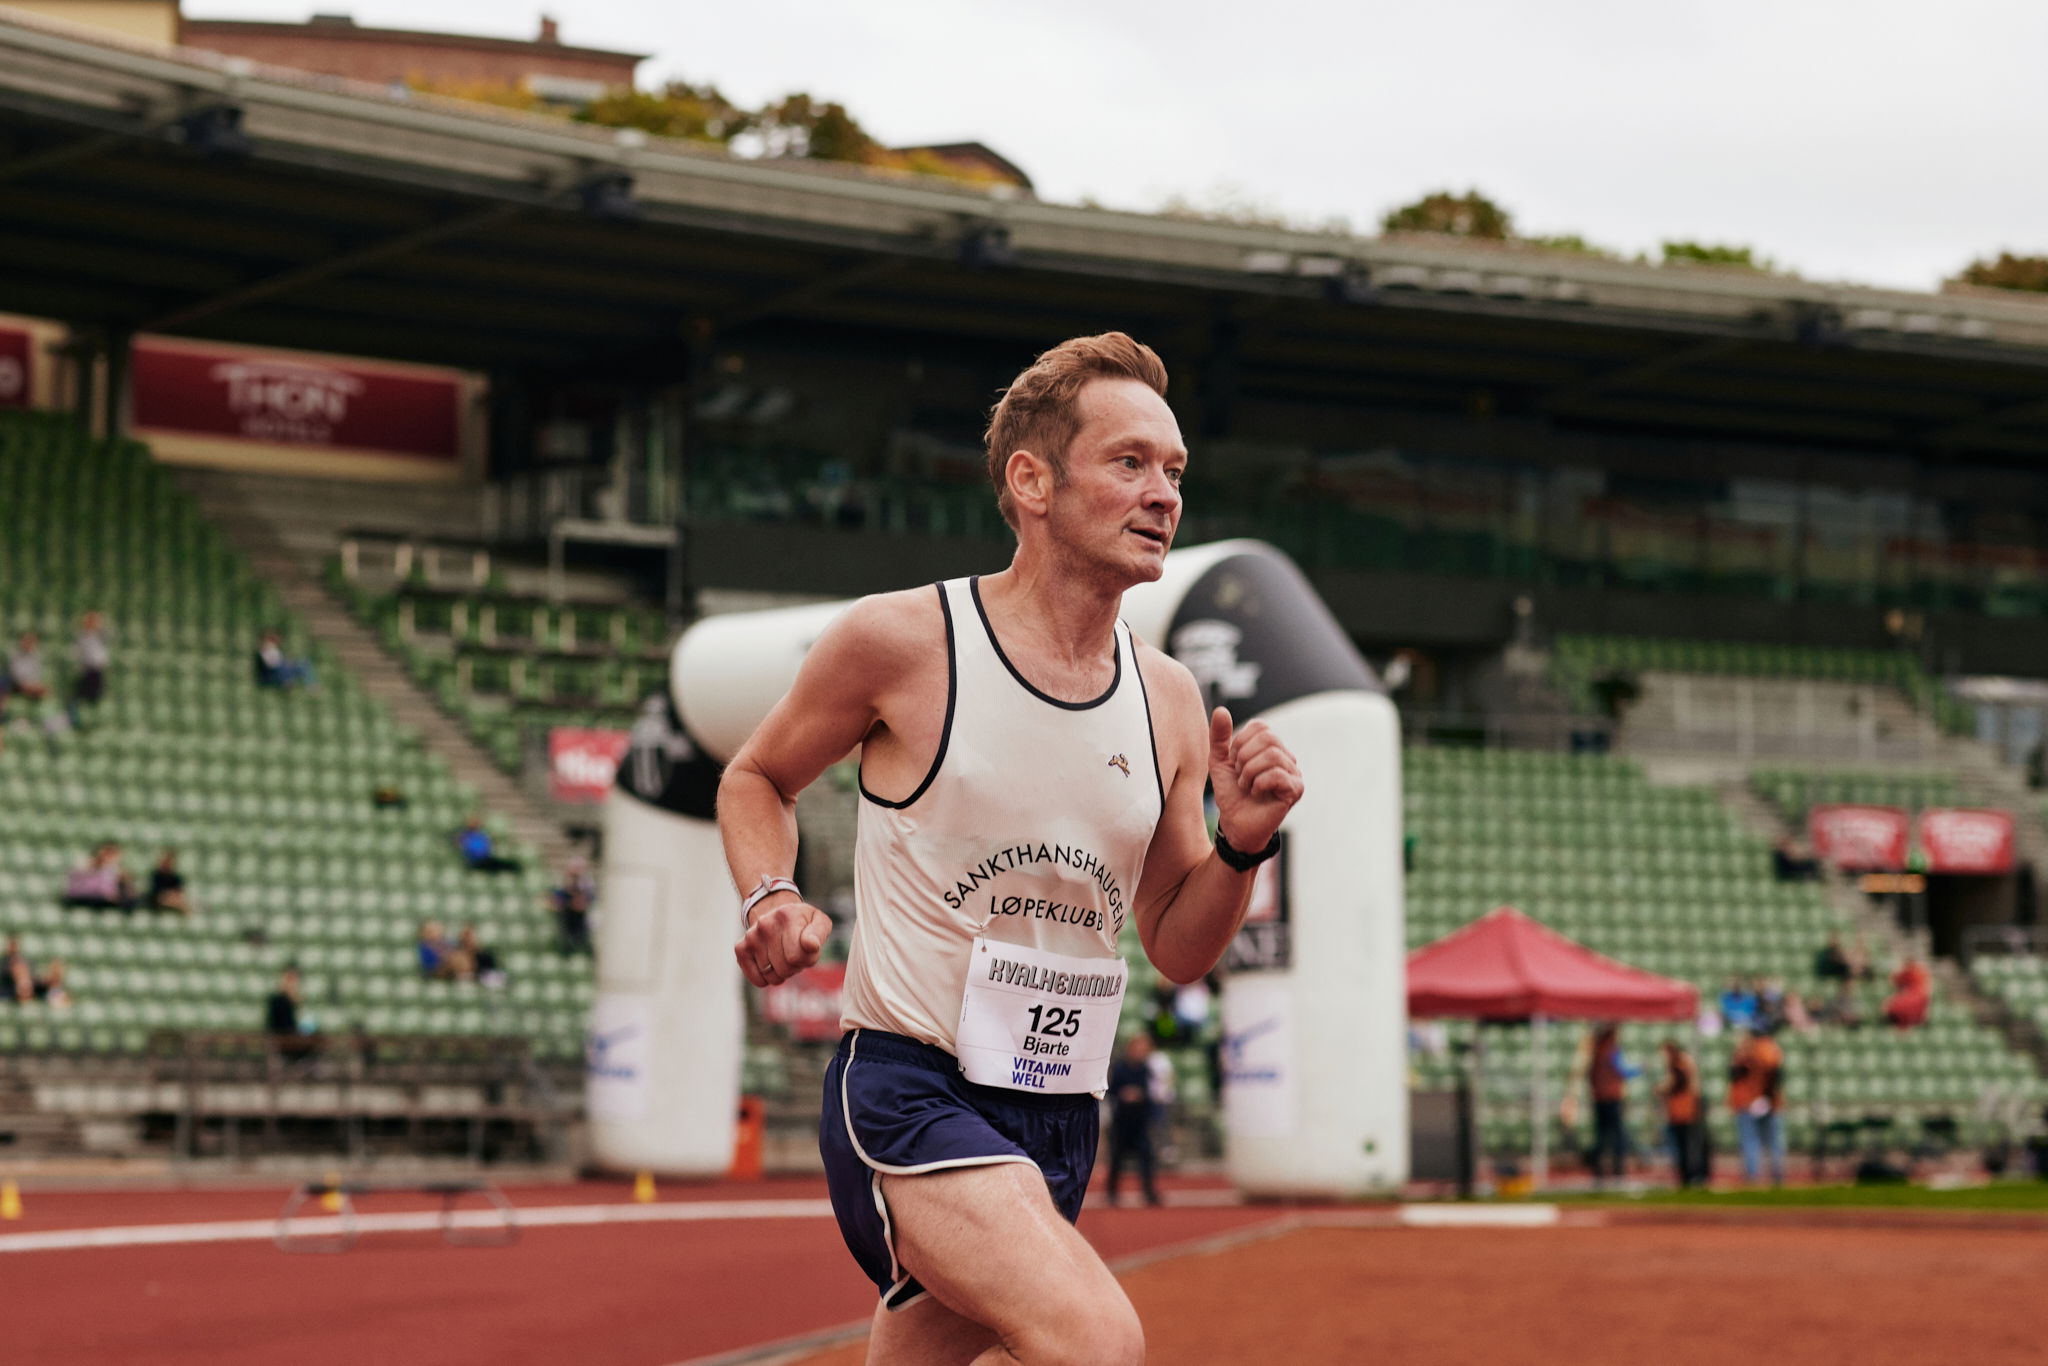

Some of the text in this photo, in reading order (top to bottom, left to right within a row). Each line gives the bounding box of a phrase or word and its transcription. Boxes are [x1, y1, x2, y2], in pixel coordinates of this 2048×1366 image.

[944, 843, 1125, 935] SANKTHANSHAUGEN
[990, 896, 1103, 931] LØPEKLUBB
[988, 957, 1123, 998] KVALHEIMMILA
[1028, 1004, 1082, 1038] 125
[1023, 1035, 1070, 1056] Bjarte
[1012, 1071, 1045, 1088] WELL
[1013, 1056, 1071, 1076] VITAMIN
